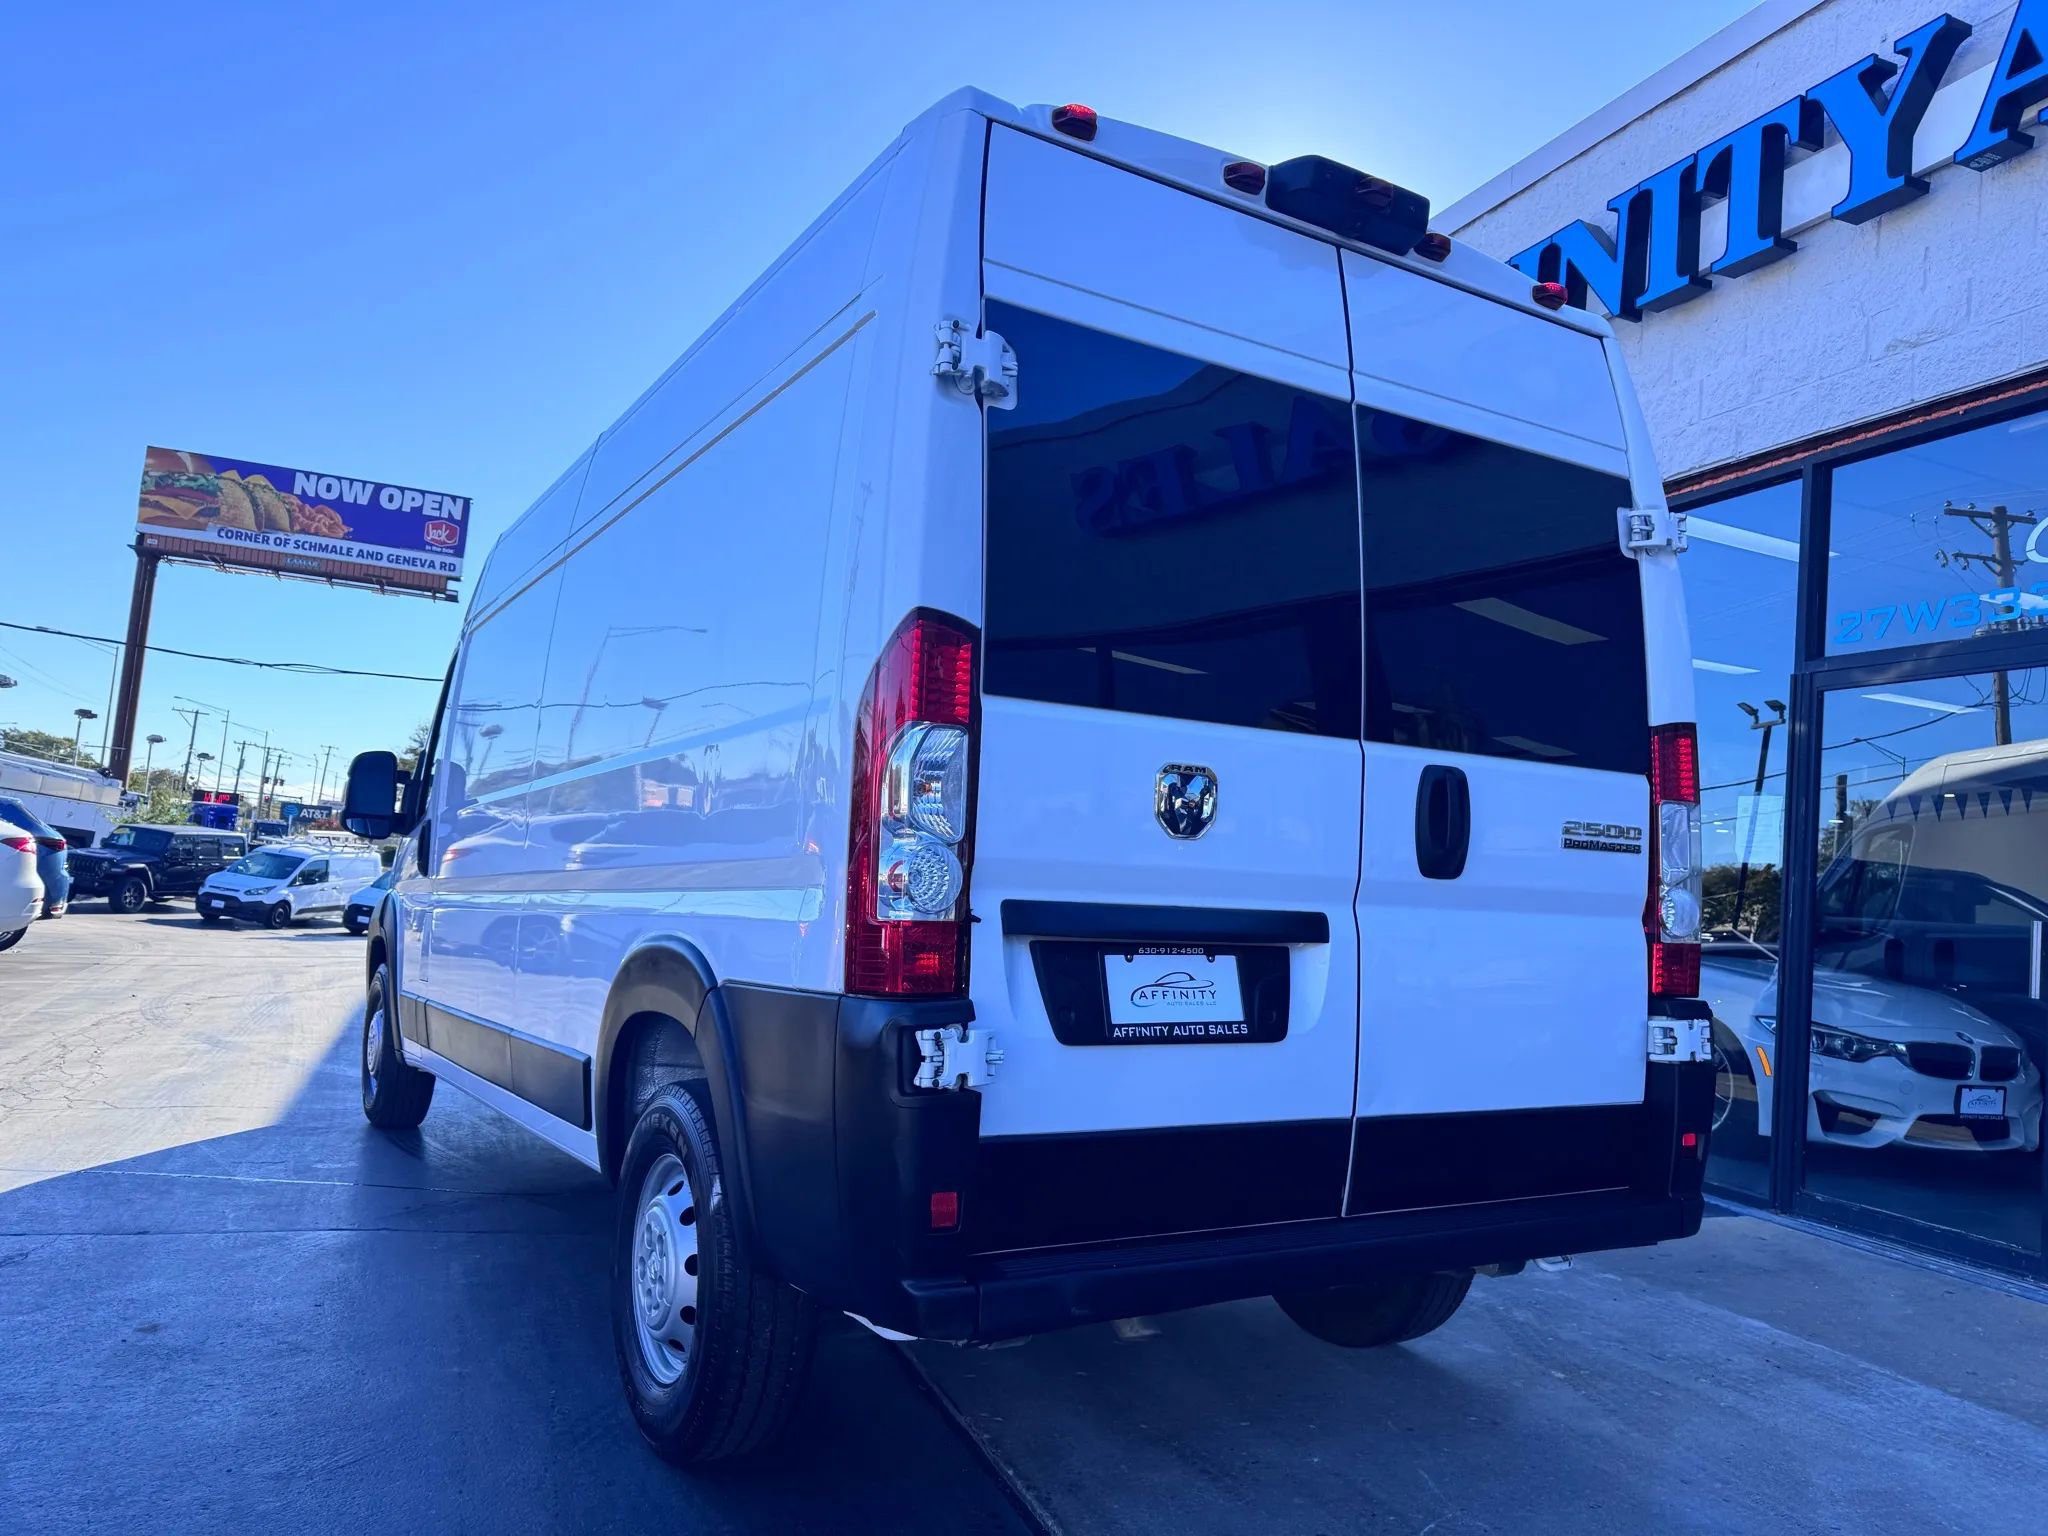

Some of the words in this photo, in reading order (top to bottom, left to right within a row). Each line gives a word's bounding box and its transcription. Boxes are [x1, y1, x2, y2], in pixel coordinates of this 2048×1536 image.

[293, 471, 375, 506] NOW
[379, 486, 464, 521] OPEN
[427, 523, 457, 543] Jack
[217, 527, 270, 547] CORNER
[274, 536, 290, 549] OF
[293, 538, 353, 559] SCHMALE
[356, 547, 383, 562] AND
[386, 552, 436, 569] GENEVA
[439, 559, 457, 573] RD
[1171, 765, 1207, 774] RAM
[299, 808, 329, 819] AT&T
[1562, 821, 1643, 840] 2500
[1138, 947, 1204, 955] 630-912-4500
[1138, 989, 1217, 1000] AFFINITY
[1113, 1026, 1169, 1038] AFFINITY
[1173, 1025, 1205, 1036] AUTO
[1208, 1024, 1248, 1035] SALES
[641, 1113, 688, 1160] NEXEN
